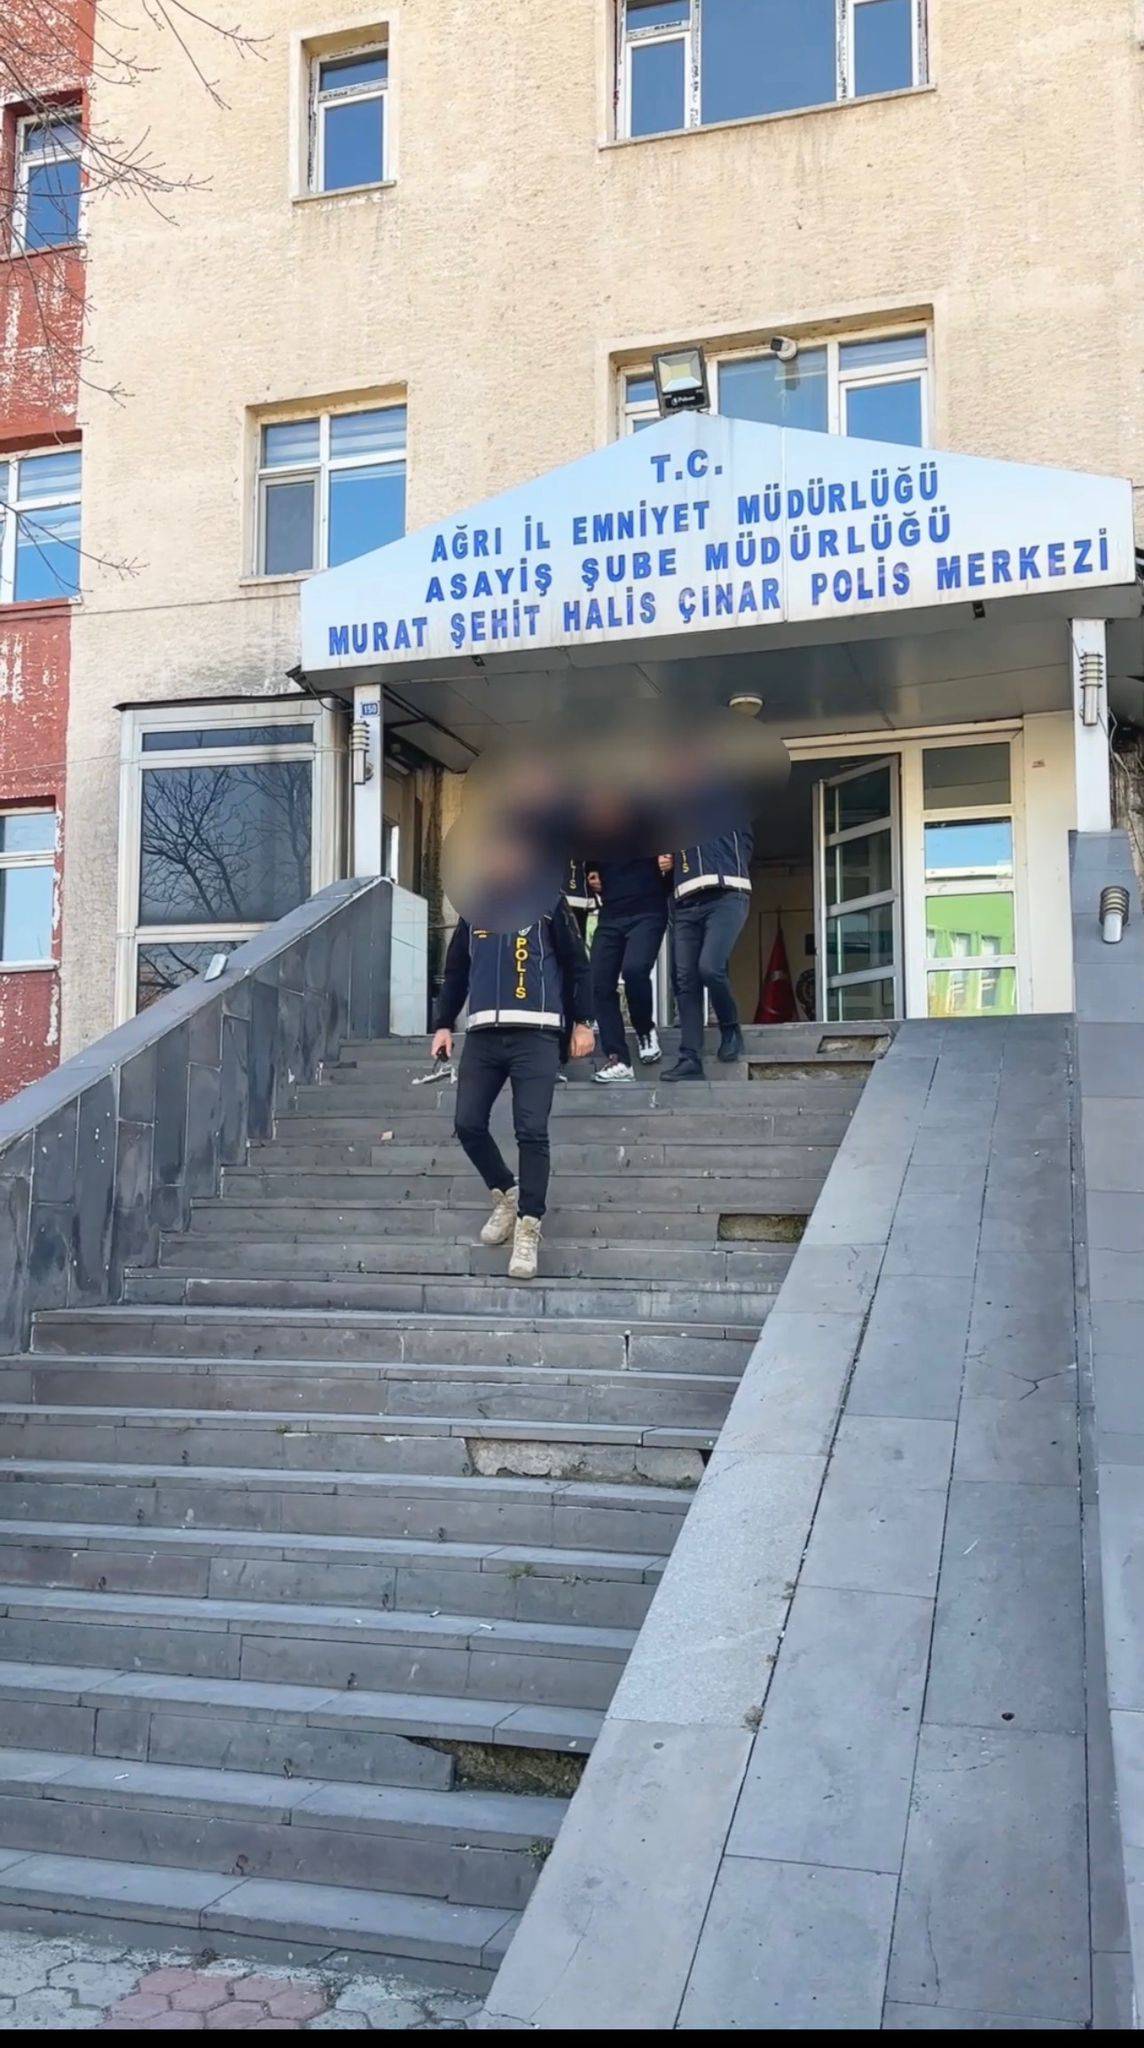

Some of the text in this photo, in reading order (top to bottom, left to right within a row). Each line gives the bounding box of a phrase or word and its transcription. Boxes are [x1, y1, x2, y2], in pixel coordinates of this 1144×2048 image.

[431, 461, 938, 563] AĞRI İL EMNİYET MÜDÜRLÜĞÜ
[651, 449, 722, 484] T.C.
[328, 527, 1109, 657] MURAT ŞEHİT HALİS ÇINAR POLİS MERKEZİ
[424, 505, 951, 604] ASAYİŞ ŞUBE MÜDÜRLÜĞÜ
